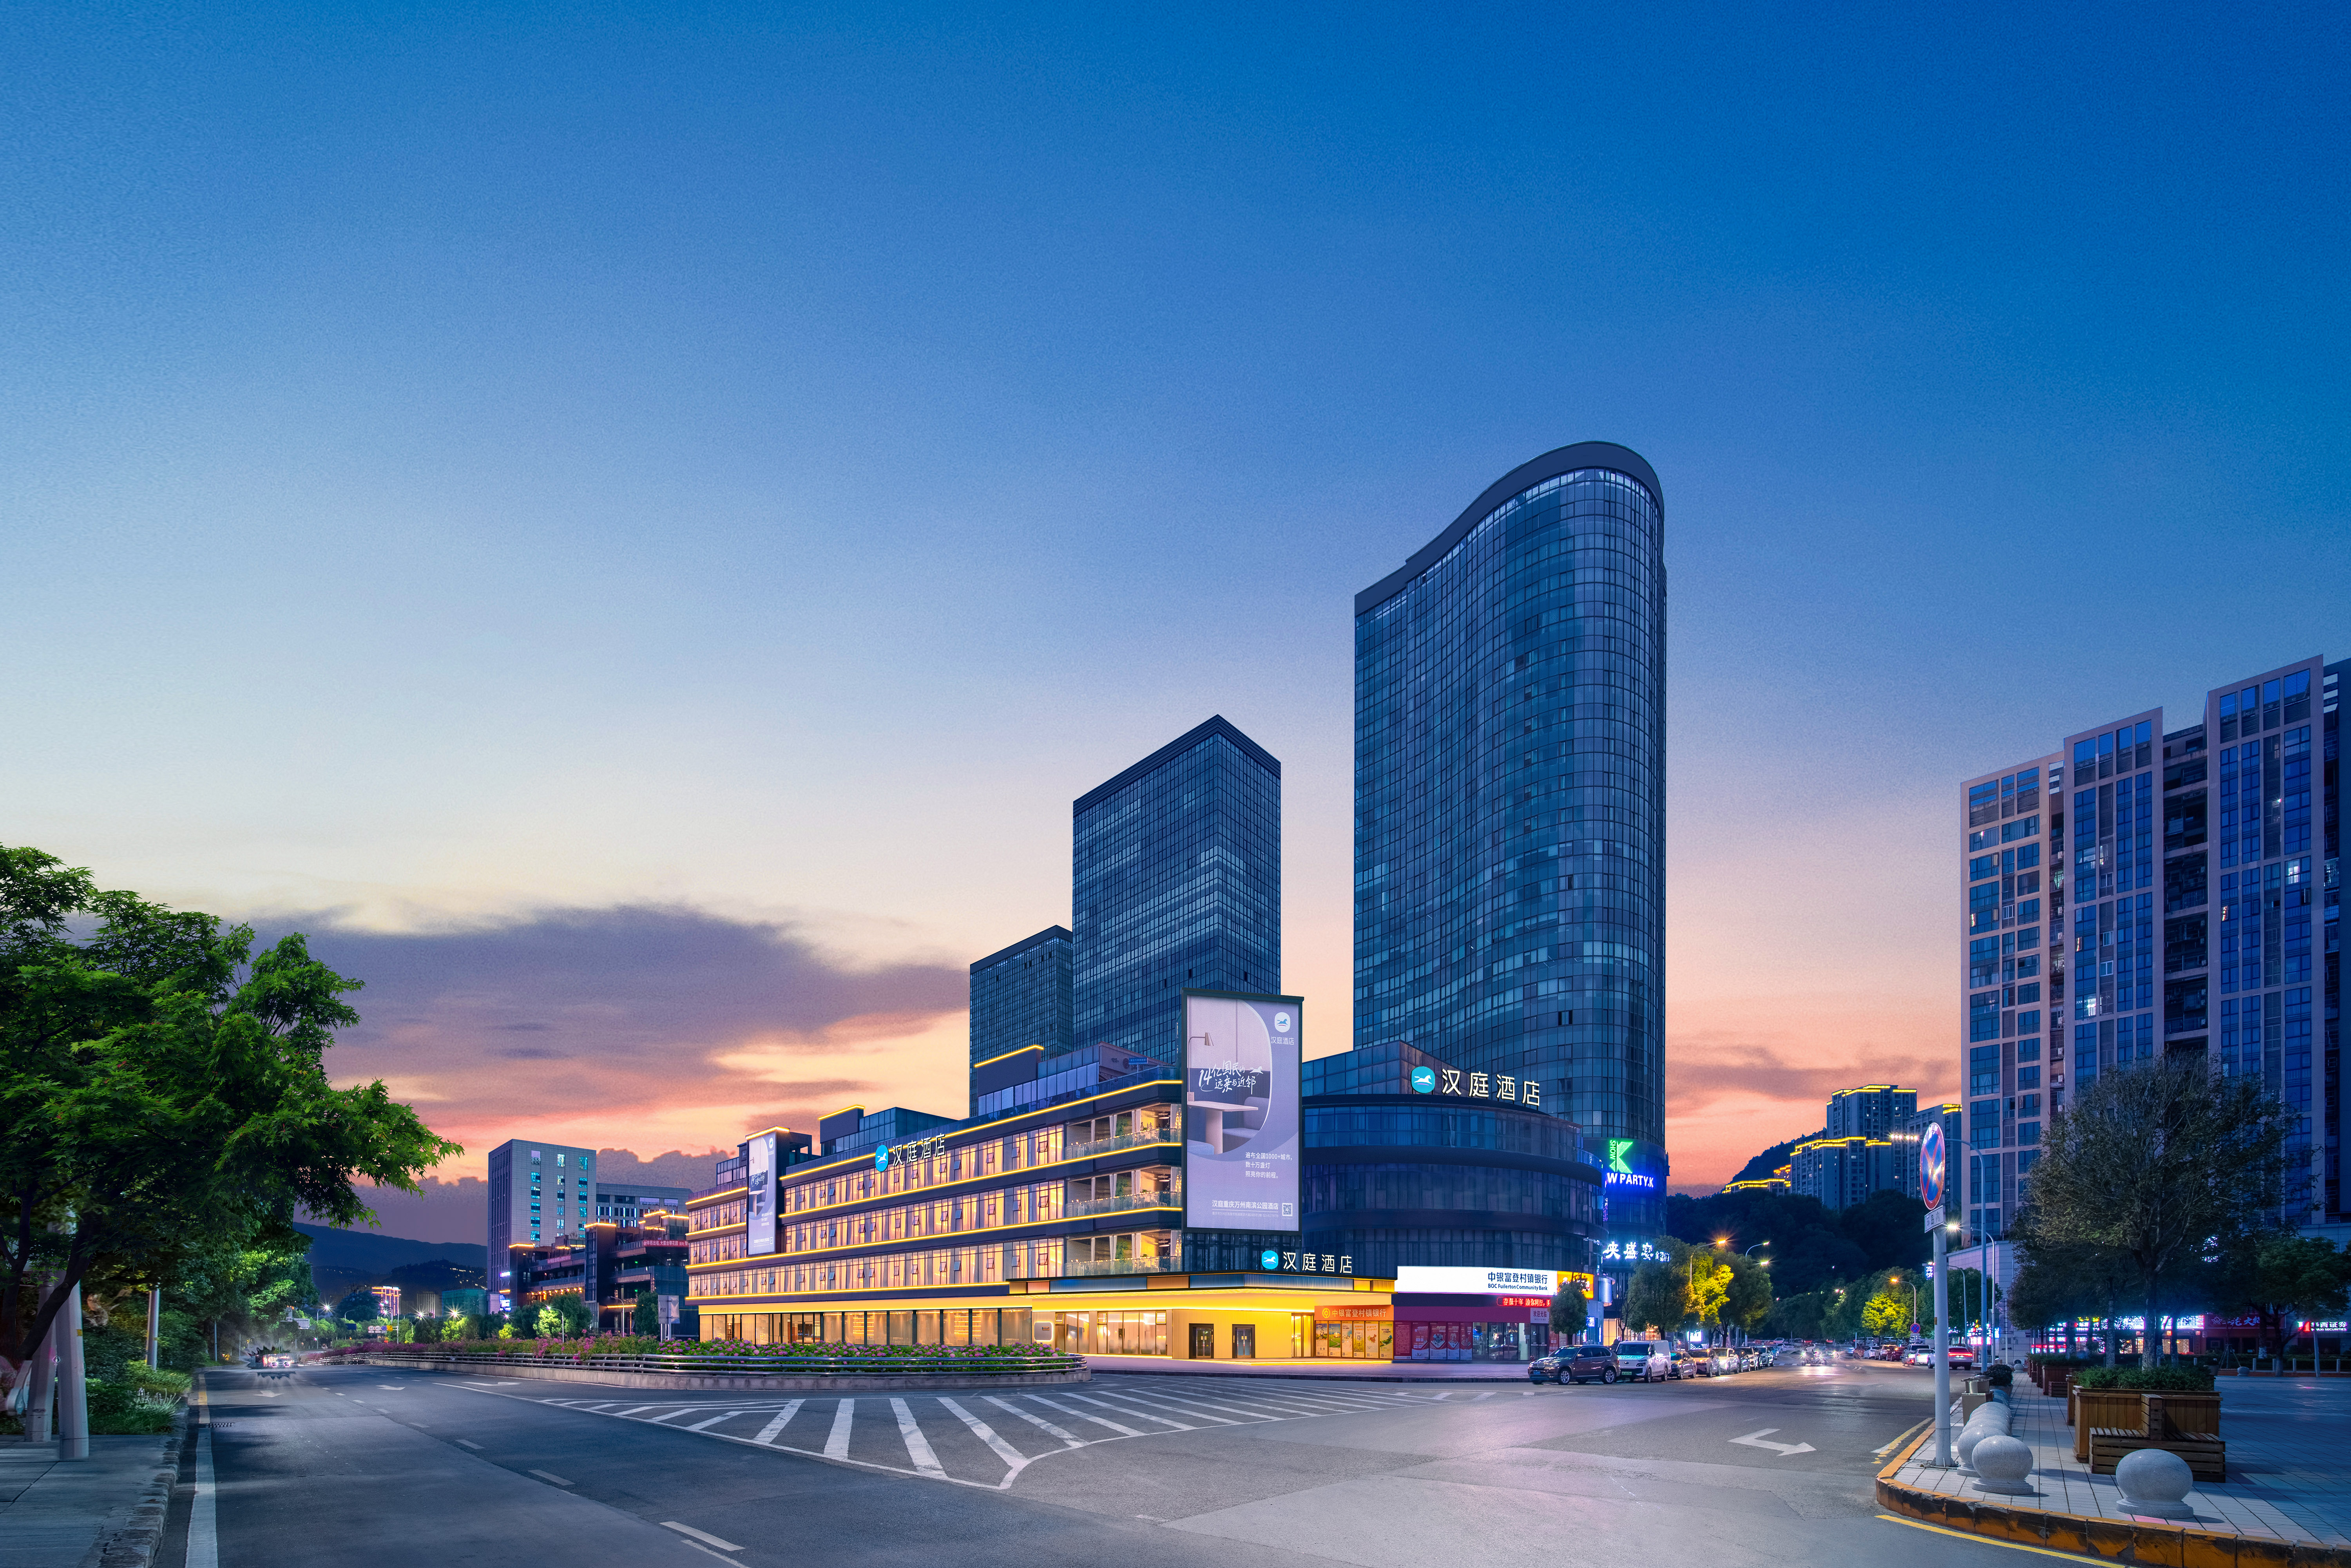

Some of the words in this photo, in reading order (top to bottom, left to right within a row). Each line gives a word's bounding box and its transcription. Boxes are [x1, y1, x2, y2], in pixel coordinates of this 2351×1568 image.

[1271, 1037, 1294, 1045] 汉庭酒店
[1442, 1068, 1540, 1106] 汉庭酒店
[893, 1133, 945, 1166] 汉庭酒店
[1212, 1200, 1279, 1210] 汉庭重庆万州南滨公园酒店
[1283, 1251, 1352, 1273] 汉庭酒店
[1488, 1272, 1548, 1284] 中银富登村镇银行
[1332, 1309, 1386, 1317] 中银富登村镇银行
